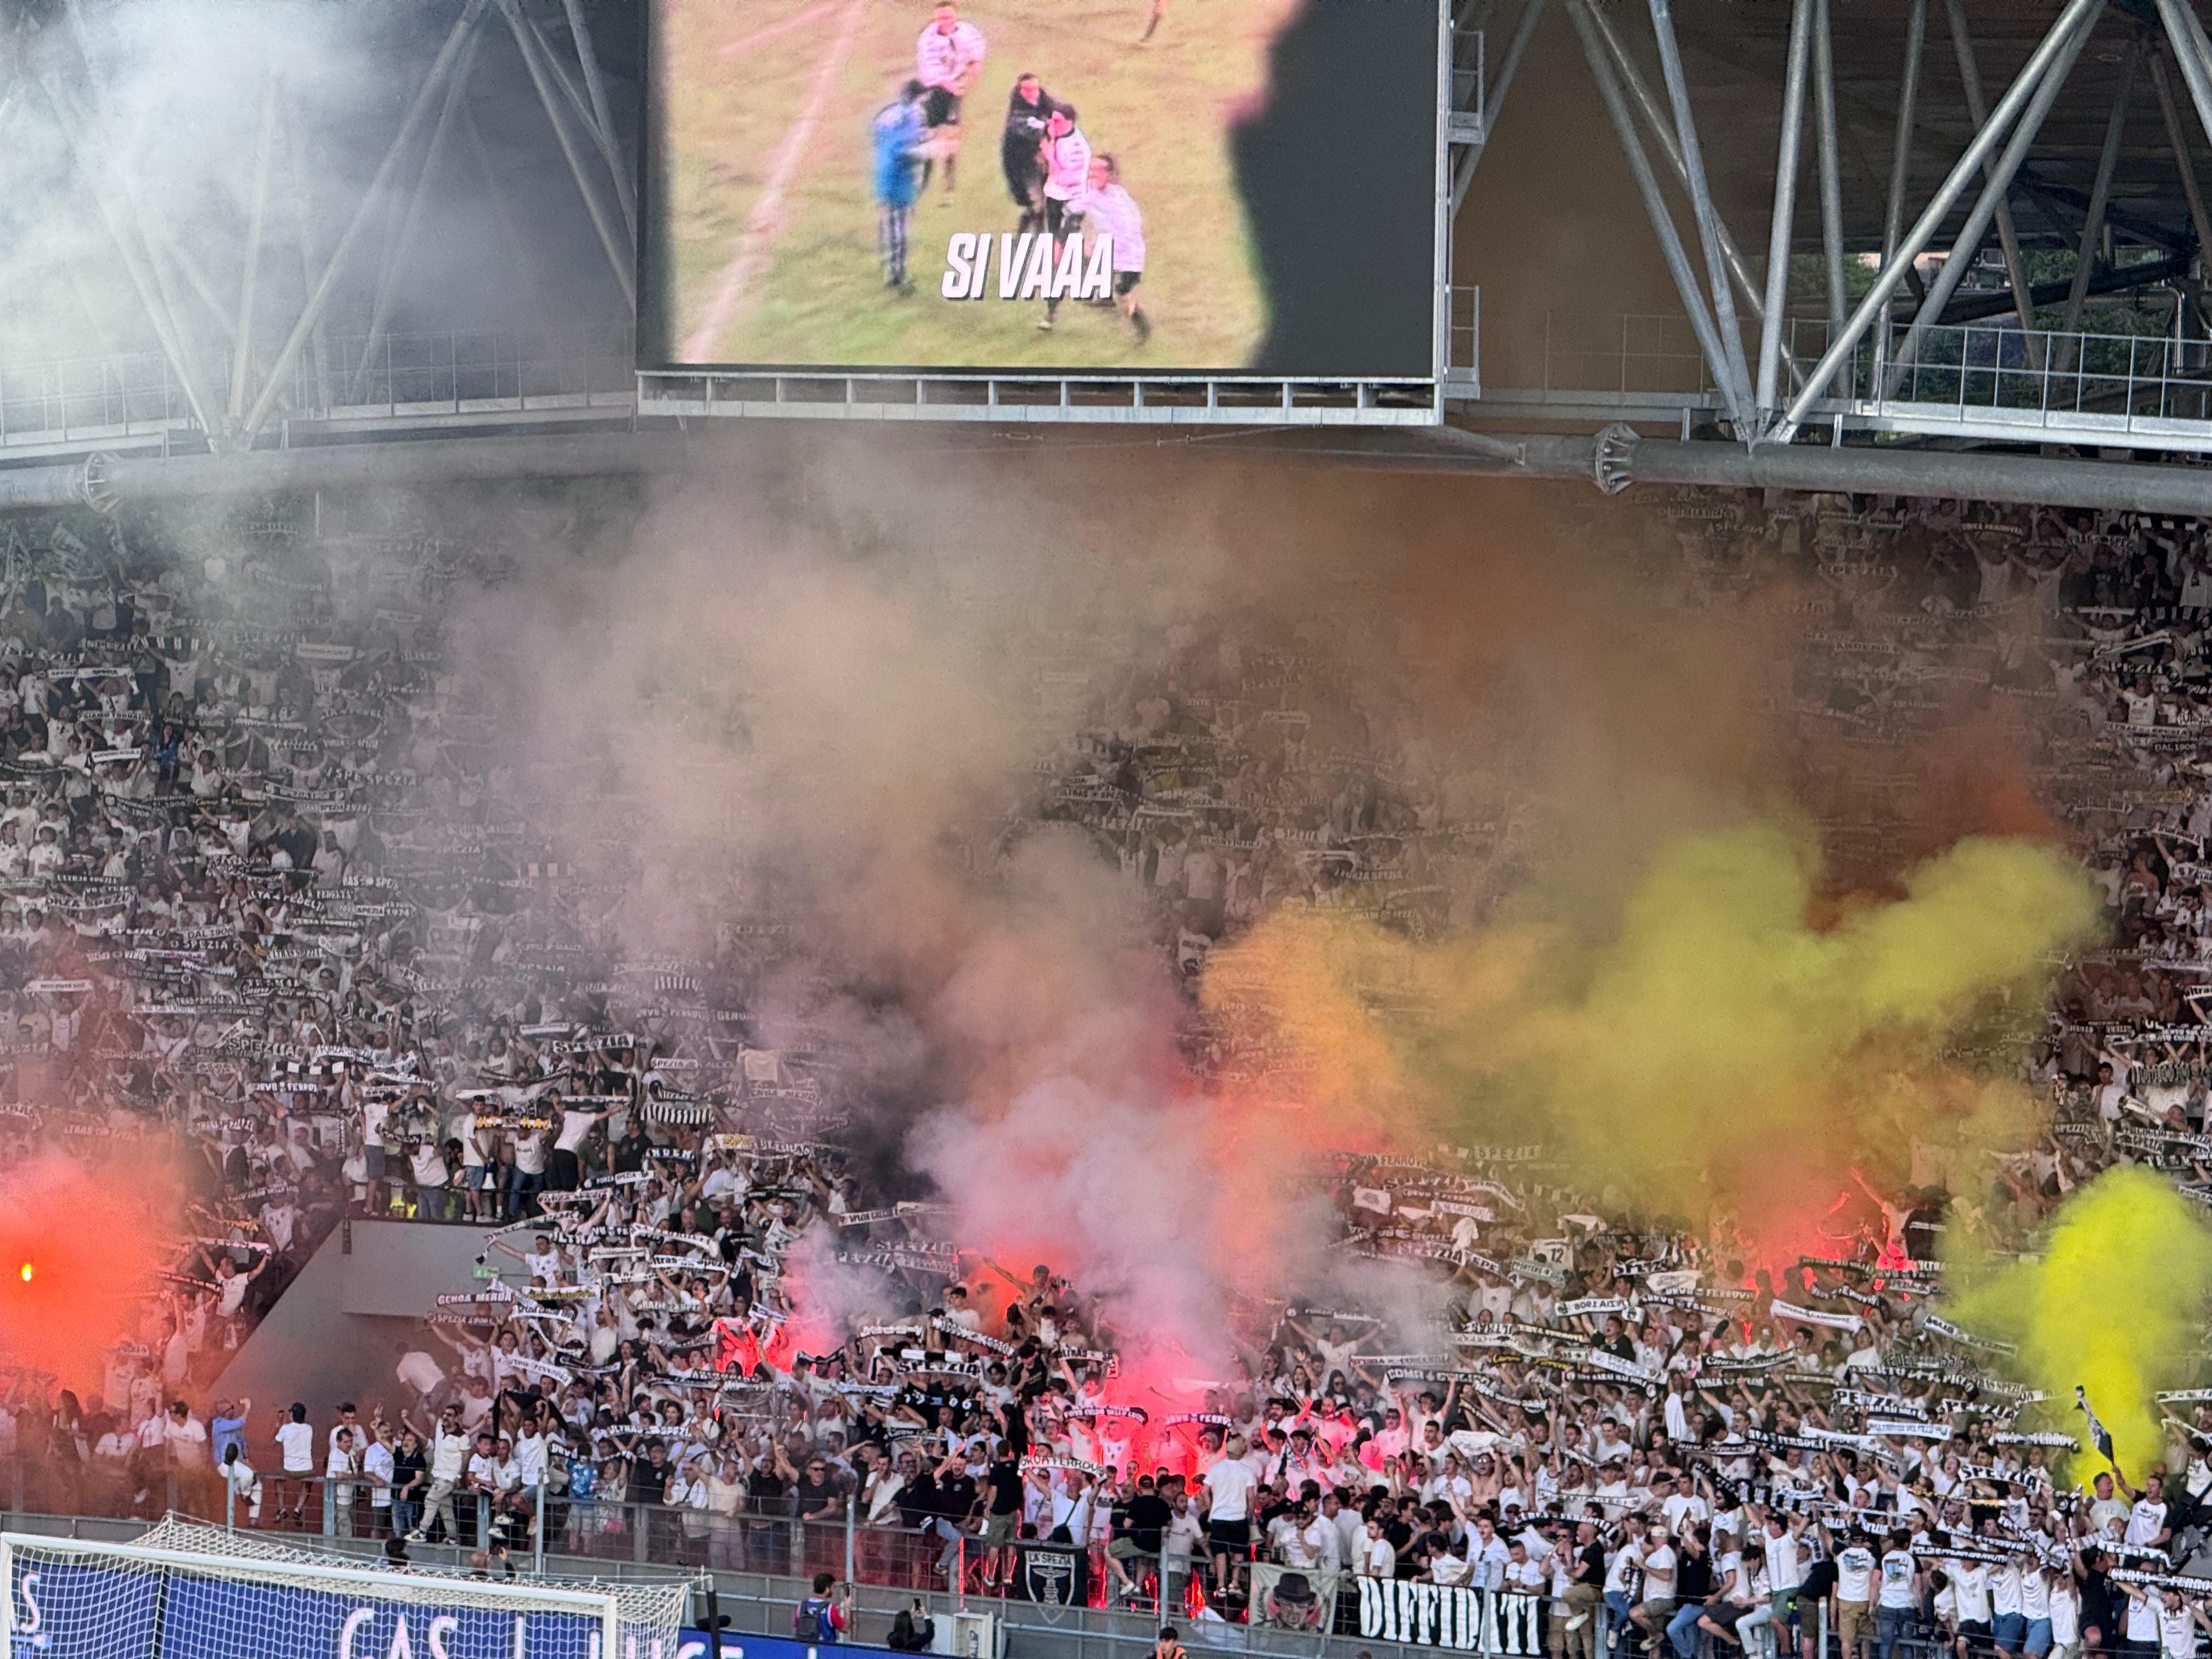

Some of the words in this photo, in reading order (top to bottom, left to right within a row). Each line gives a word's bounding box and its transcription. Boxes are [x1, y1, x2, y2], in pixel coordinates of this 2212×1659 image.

[941, 232, 992, 301] SI
[999, 232, 1115, 301] VAAA
[183, 940, 228, 951] SPEZIA
[596, 1176, 614, 1184] FORZA
[616, 1172, 636, 1180] SPEZIA
[1550, 1248, 1564, 1260] 12
[437, 1294, 473, 1305] GENOA
[476, 1292, 513, 1303] MERDA
[1029, 1552, 1040, 1562] LA
[1042, 1553, 1071, 1565] SPEZIA
[1357, 1576, 1541, 1656] DIFFIDATI
